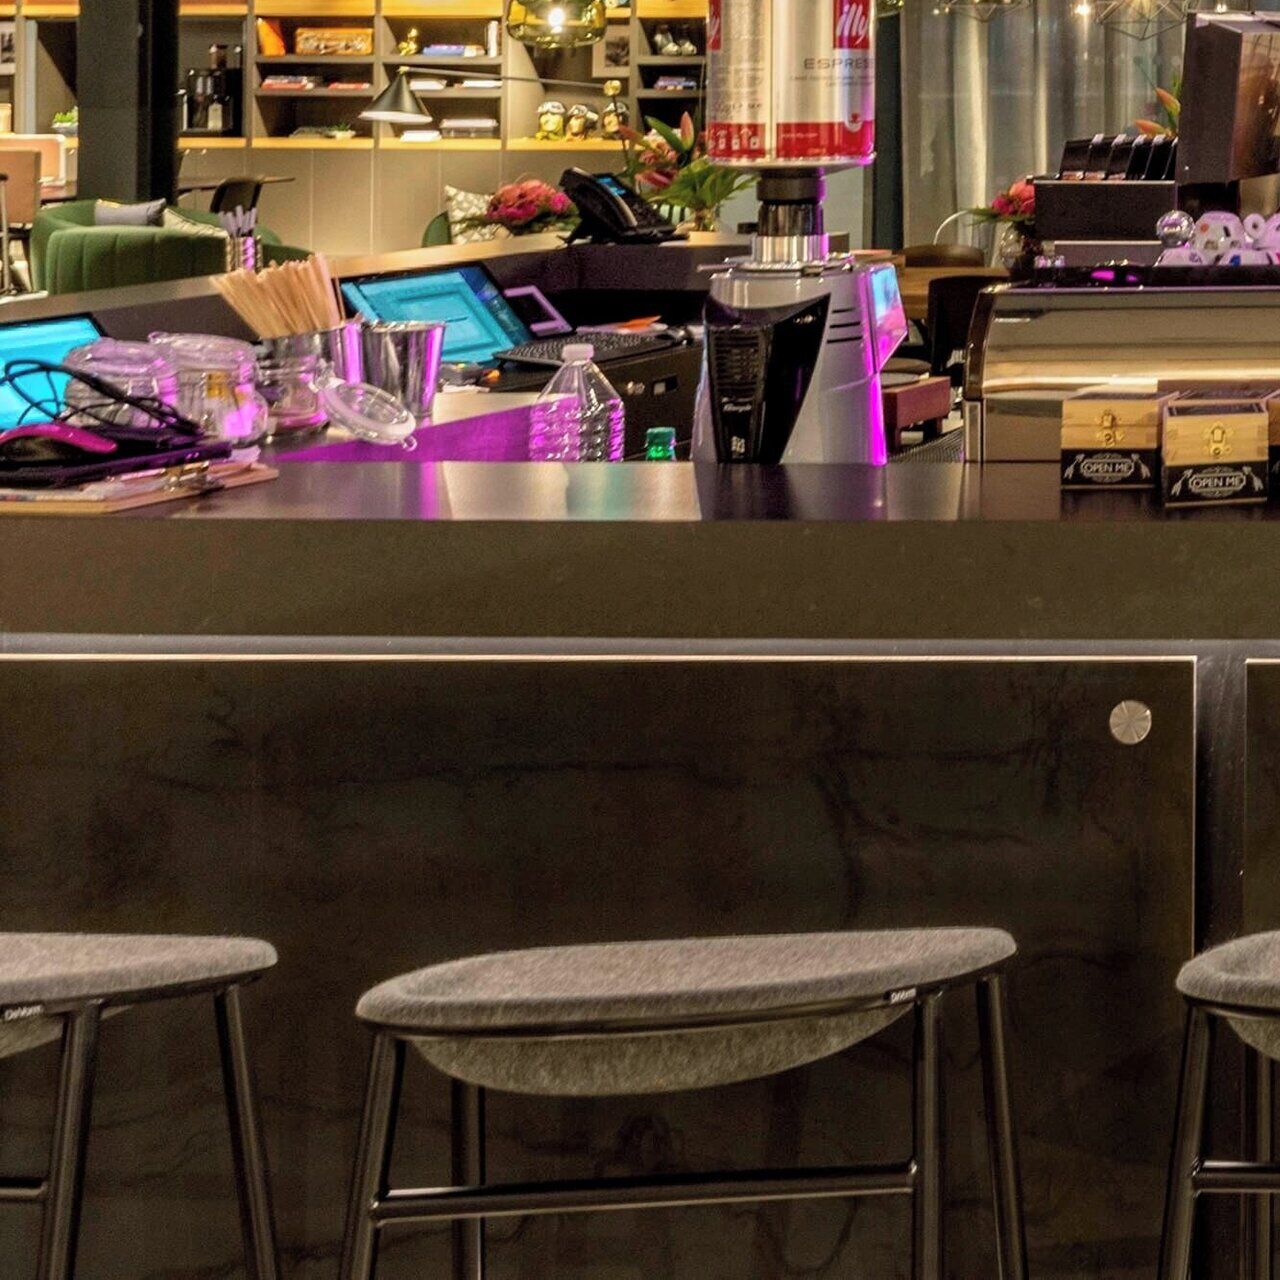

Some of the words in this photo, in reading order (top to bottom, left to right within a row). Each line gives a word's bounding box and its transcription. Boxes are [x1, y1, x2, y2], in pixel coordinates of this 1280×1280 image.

[836, 3, 868, 45] illy
[1085, 462, 1115, 471] OPEN
[1117, 461, 1131, 471] ME
[1193, 479, 1224, 488] OPEN
[1226, 478, 1242, 487] ME
